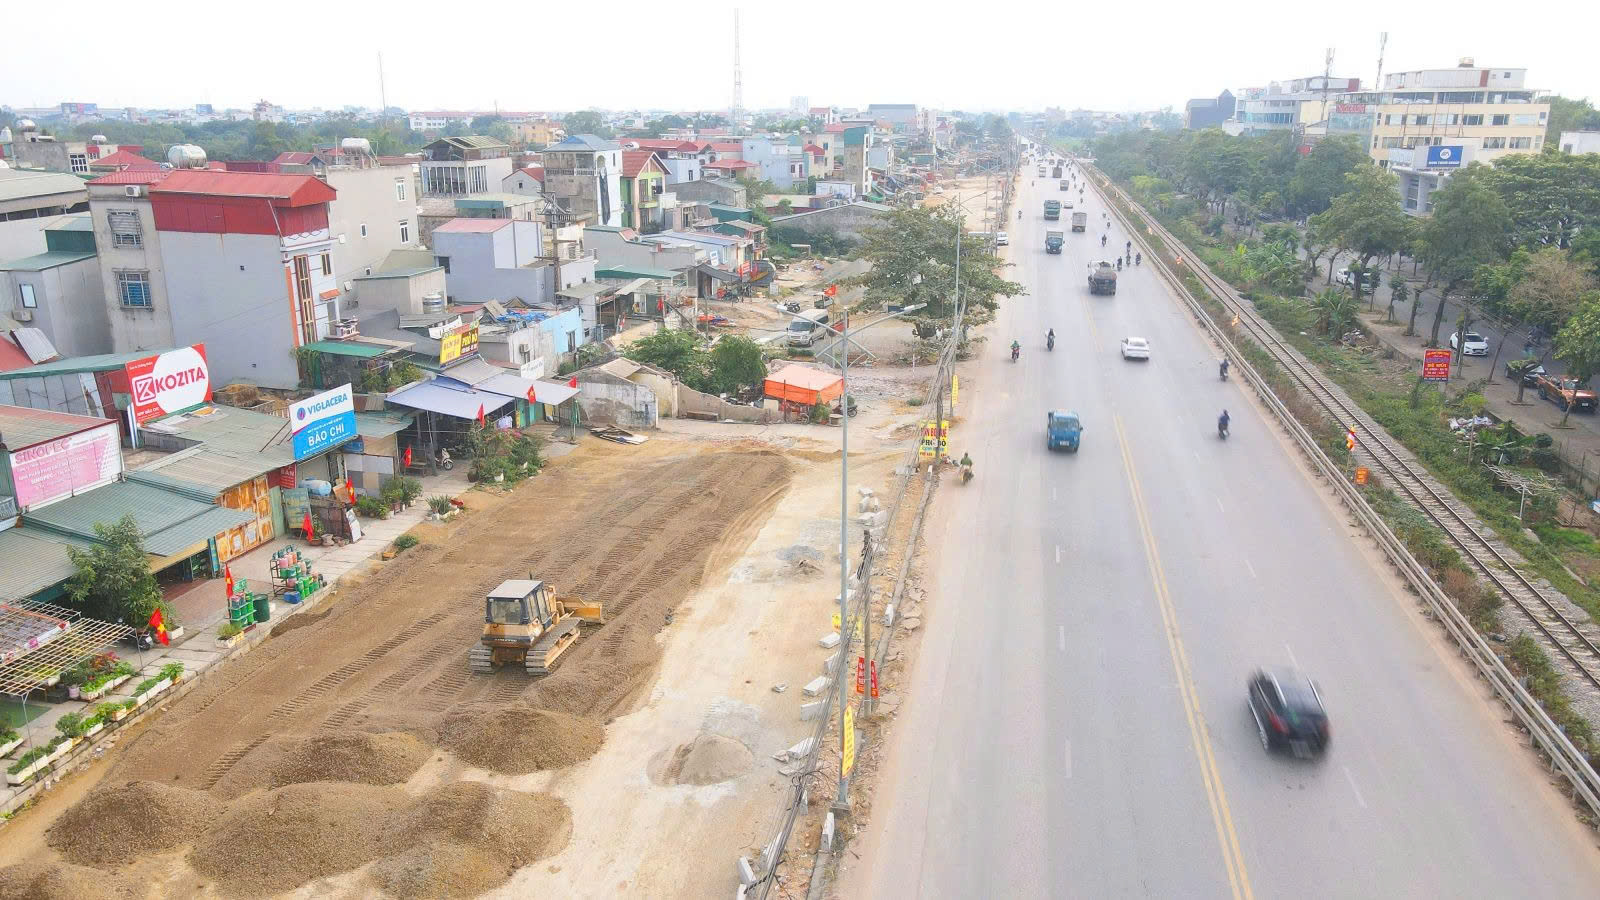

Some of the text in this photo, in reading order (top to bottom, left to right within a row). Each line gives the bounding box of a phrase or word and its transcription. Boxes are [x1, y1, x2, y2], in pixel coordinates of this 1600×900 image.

[155, 366, 206, 393] KOZITA
[307, 392, 348, 415] VIGLACERA
[329, 422, 345, 437] CHI
[15, 438, 70, 465] SINOPEC
